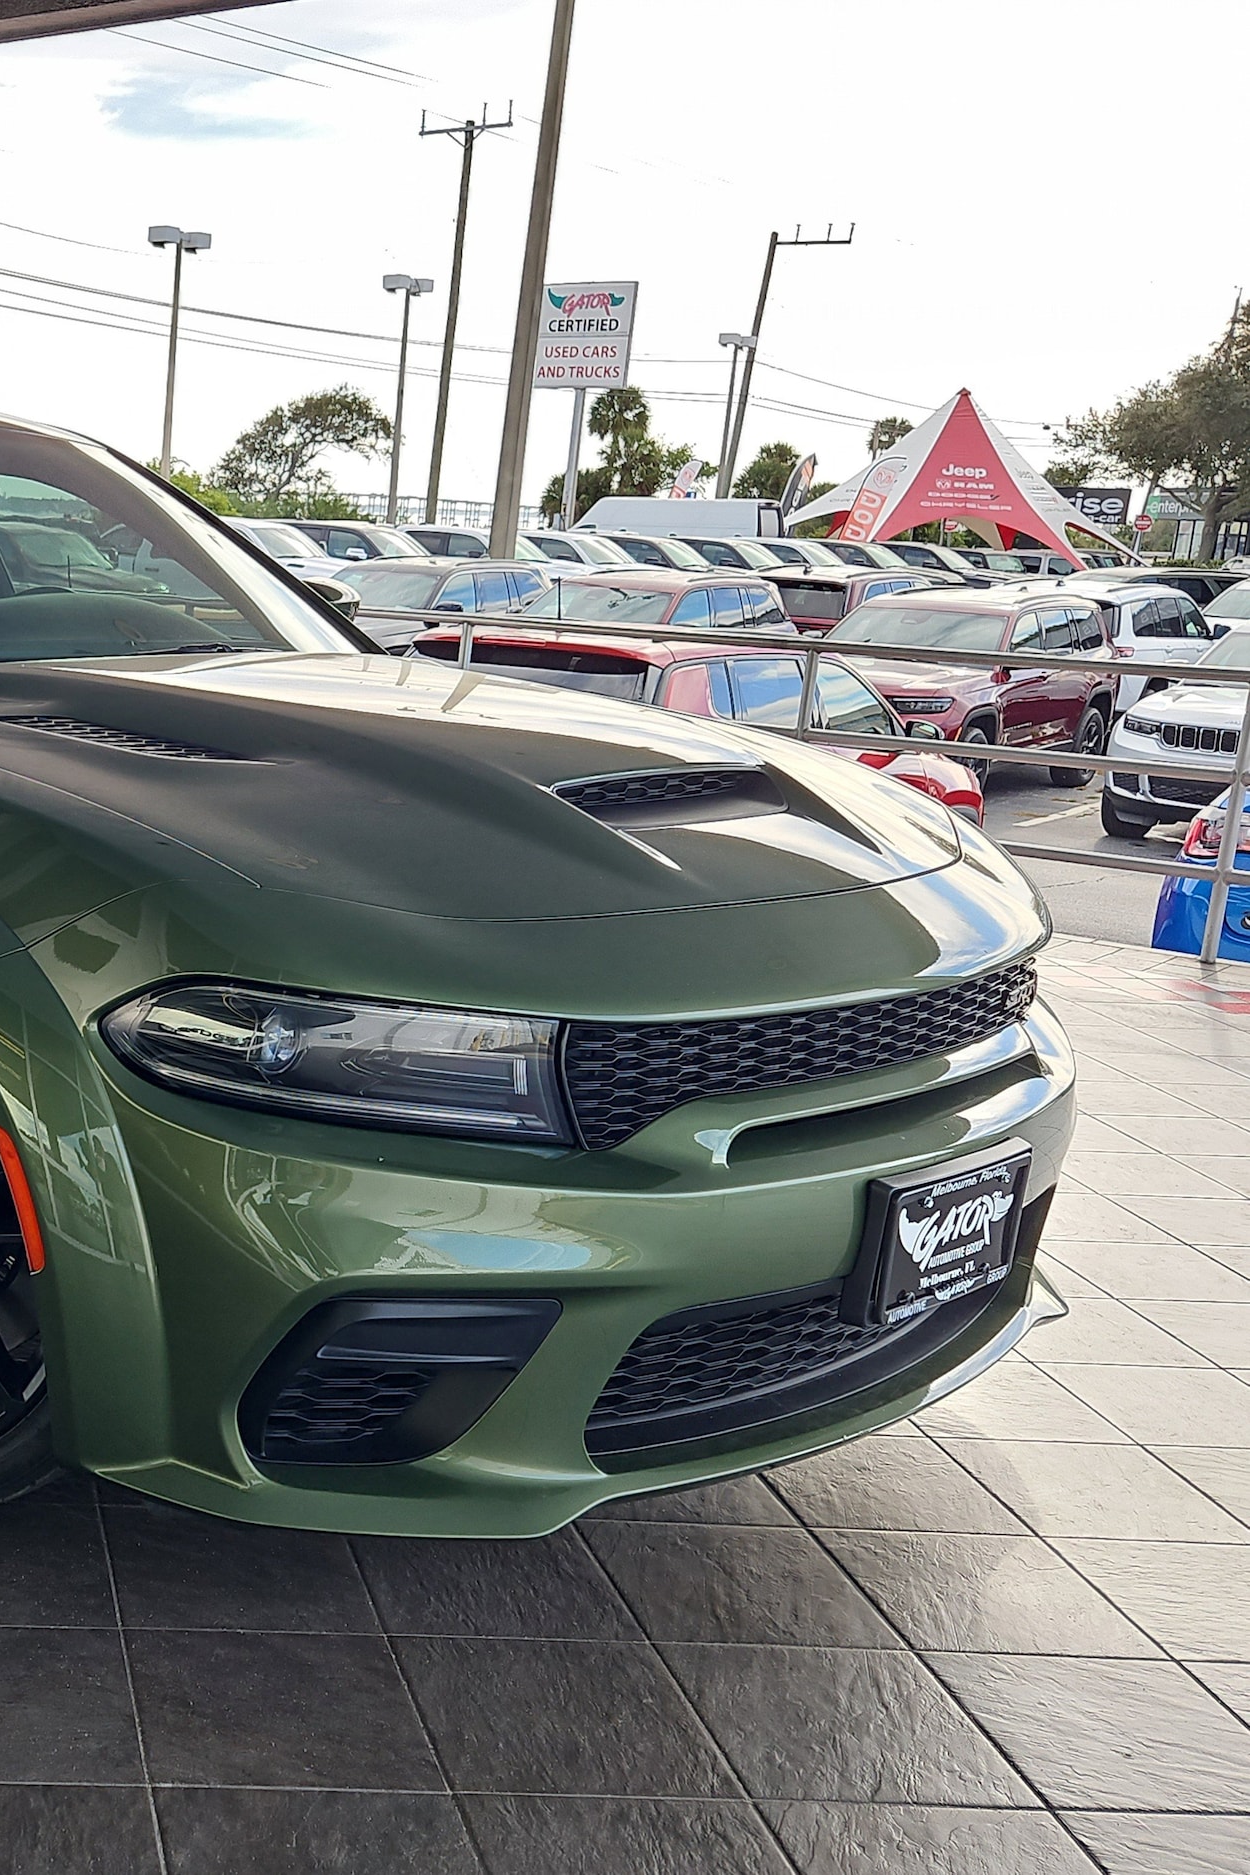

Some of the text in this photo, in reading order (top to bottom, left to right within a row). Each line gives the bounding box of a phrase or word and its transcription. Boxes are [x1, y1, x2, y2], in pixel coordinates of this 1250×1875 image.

[562, 293, 611, 318] GATOR
[548, 318, 619, 332] CERTIFIED
[544, 345, 617, 358] USED CARS
[537, 366, 620, 378] AND TRUCKS
[941, 463, 987, 479] Jeep
[953, 481, 994, 490] RAM
[920, 501, 1012, 511] CHRYSLER
[912, 1195, 992, 1272] GATOR
[928, 1239, 985, 1269] AUTOMOTIVE GROUP
[887, 1300, 928, 1324] AUTOMOTIVE
[987, 1267, 1008, 1285] GROUP
